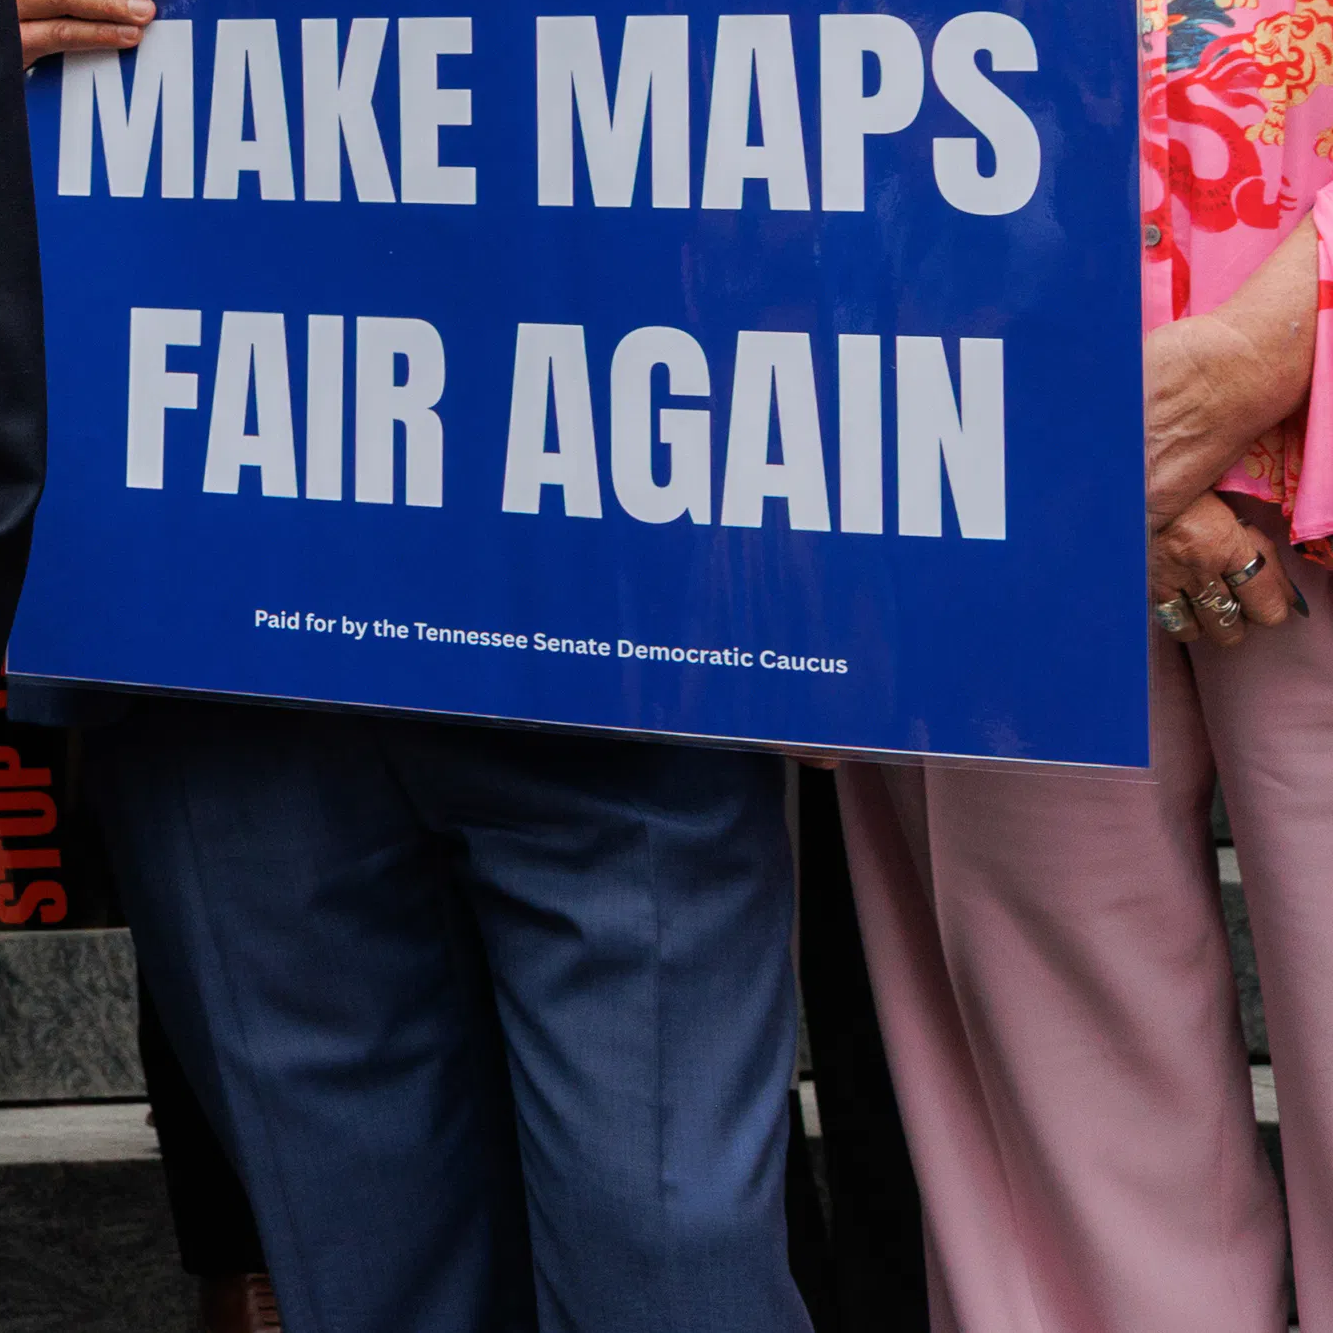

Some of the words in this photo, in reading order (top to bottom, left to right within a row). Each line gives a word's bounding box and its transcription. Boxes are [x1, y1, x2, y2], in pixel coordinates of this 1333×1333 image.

[58, 17, 478, 205] MAKE
[535, 11, 1042, 216] MAPS
[126, 306, 446, 508] FAIR
[501, 322, 1007, 541] AGAIN
[254, 609, 301, 631] Paid
[304, 612, 337, 634] for
[341, 615, 369, 641] by
[373, 618, 410, 640] the
[413, 621, 529, 650] Tennessee
[533, 632, 611, 657] Senate
[617, 639, 755, 668] Democratic
[759, 649, 849, 675] Caucus
